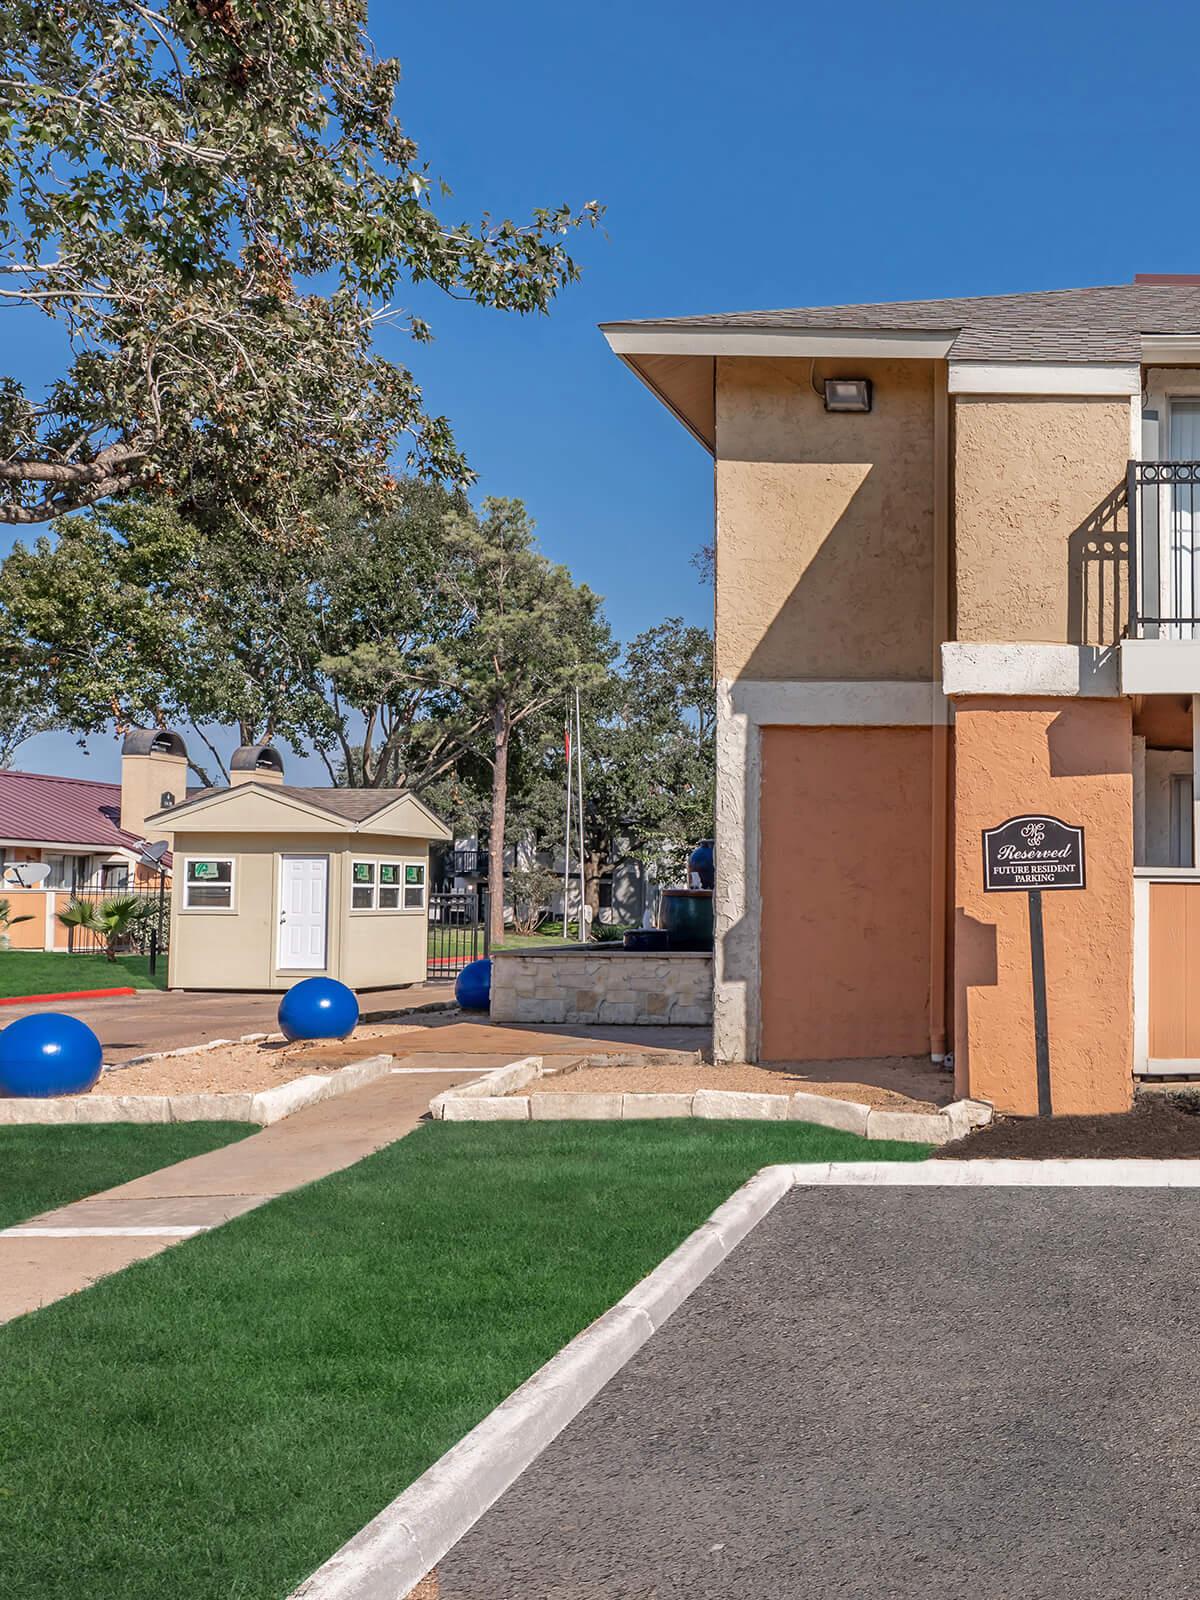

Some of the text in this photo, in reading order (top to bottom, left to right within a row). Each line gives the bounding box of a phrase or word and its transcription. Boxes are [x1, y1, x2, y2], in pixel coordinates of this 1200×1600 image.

[998, 844, 1072, 860] Reserved
[993, 864, 1076, 874] FUTURE RESIDENT
[1015, 874, 1055, 882] PARKING
